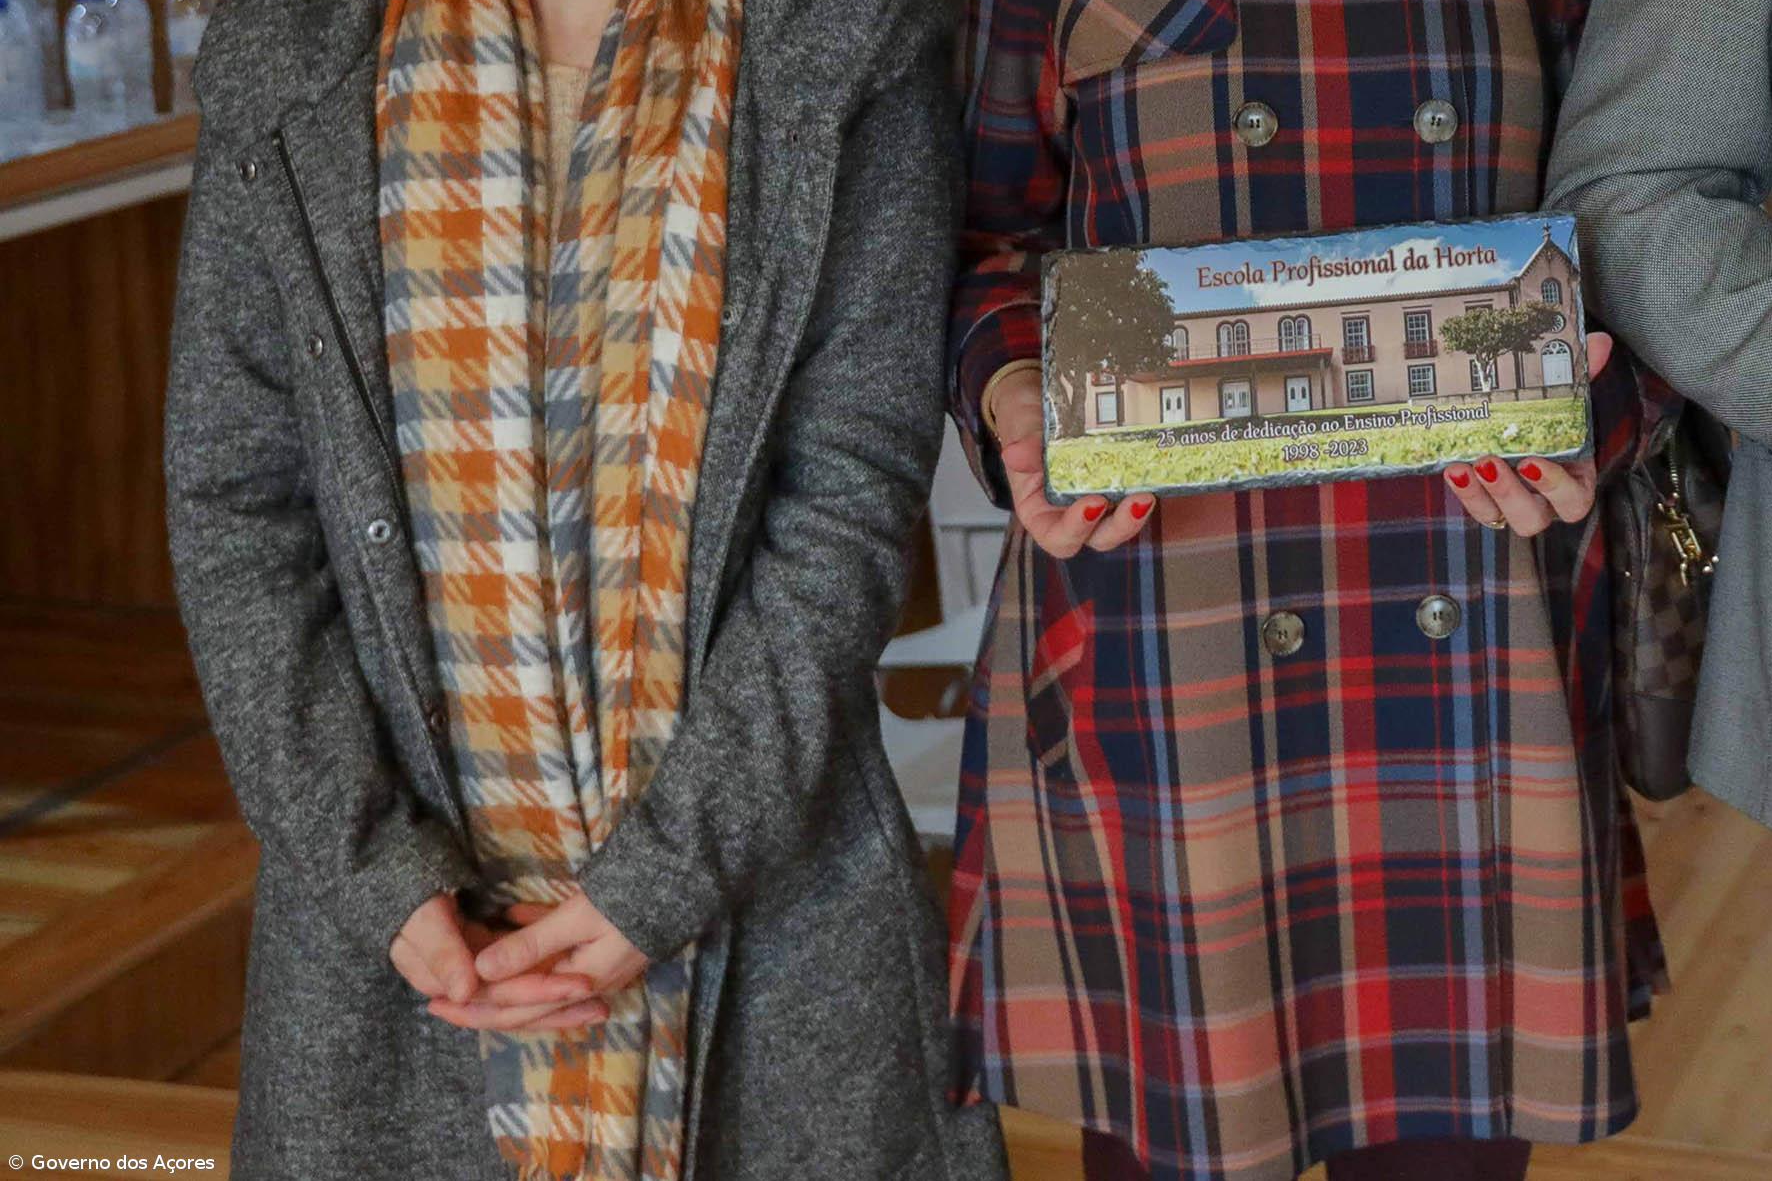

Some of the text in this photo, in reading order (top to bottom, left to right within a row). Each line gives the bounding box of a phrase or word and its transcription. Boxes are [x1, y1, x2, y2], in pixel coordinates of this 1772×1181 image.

[1197, 245, 1497, 289] Escola Profissional da Horta
[1157, 401, 1491, 448] 25 anos de dedicação ao Ensino Profissional
[1282, 445, 1320, 461] 1998
